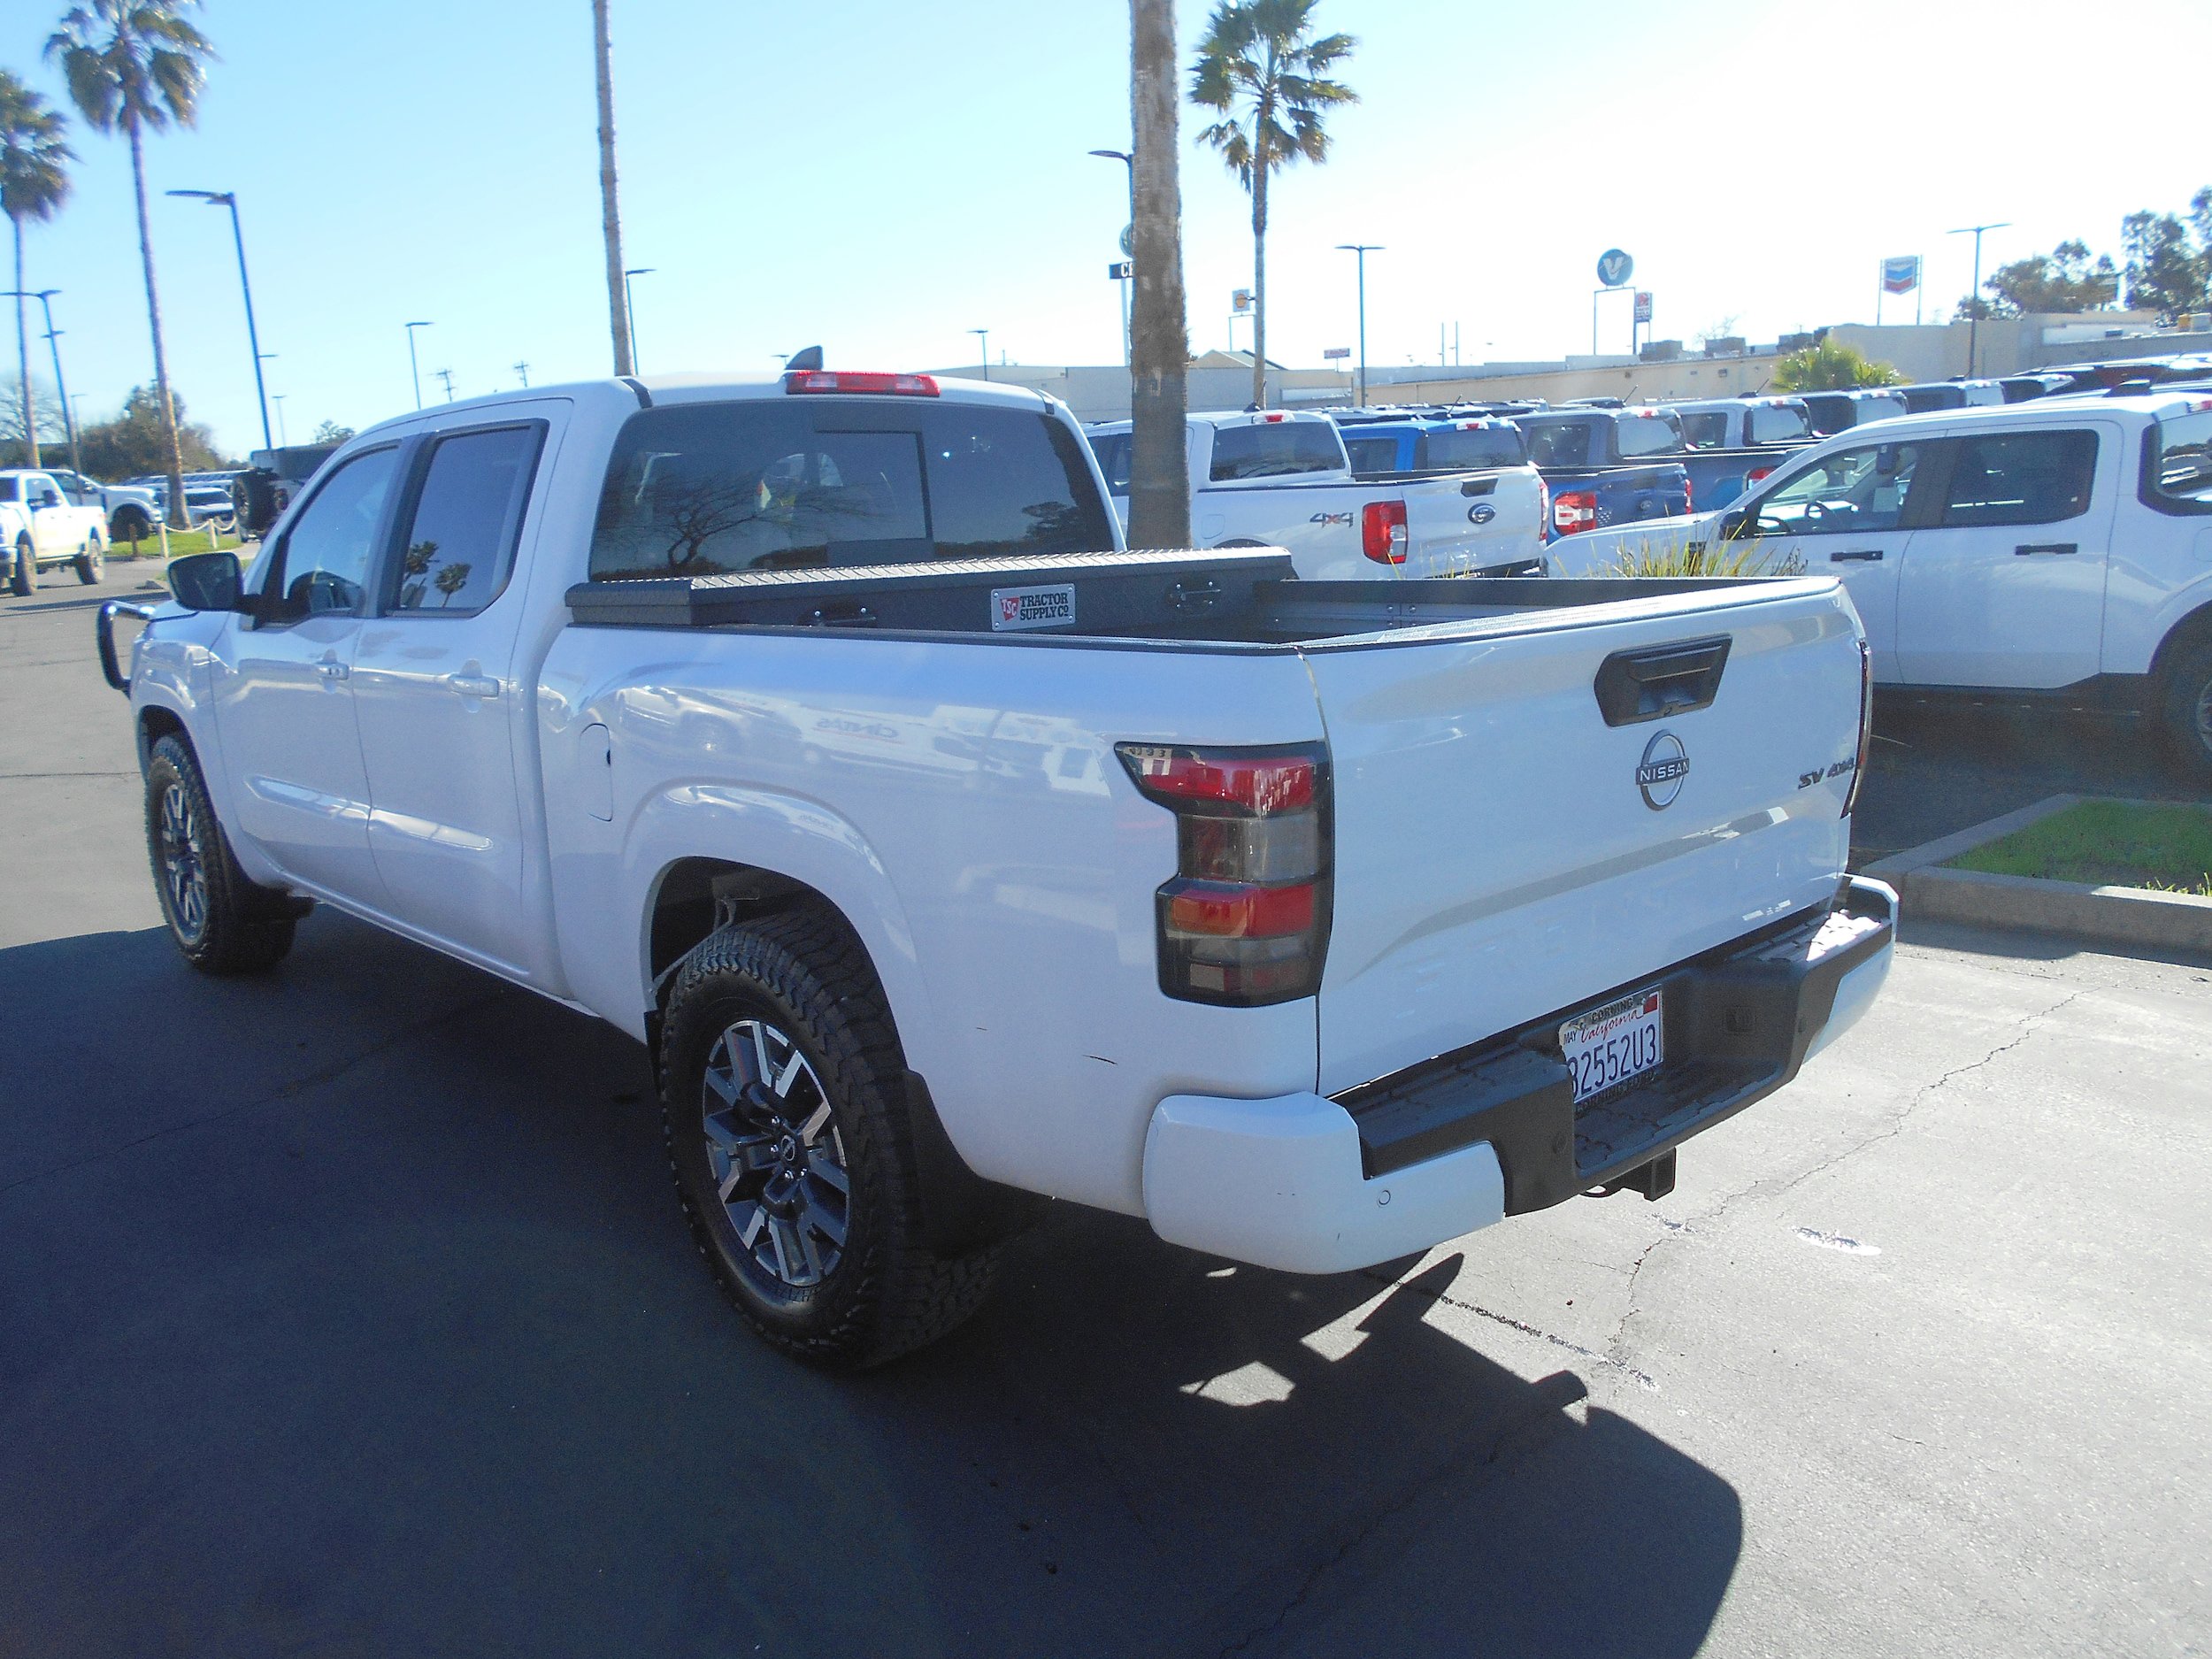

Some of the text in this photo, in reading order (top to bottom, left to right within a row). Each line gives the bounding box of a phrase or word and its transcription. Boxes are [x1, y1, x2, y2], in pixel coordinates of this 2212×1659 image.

[1001, 599, 1018, 617] TSC
[1019, 592, 1068, 608] TRACTOR
[1020, 607, 1057, 620] SUPPLY
[1639, 761, 1689, 782] NISSAN
[1798, 767, 1824, 790] SV
[1591, 996, 1634, 1024] CORNING
[1581, 1009, 1644, 1043] California
[1563, 1029, 1578, 1045] MAY
